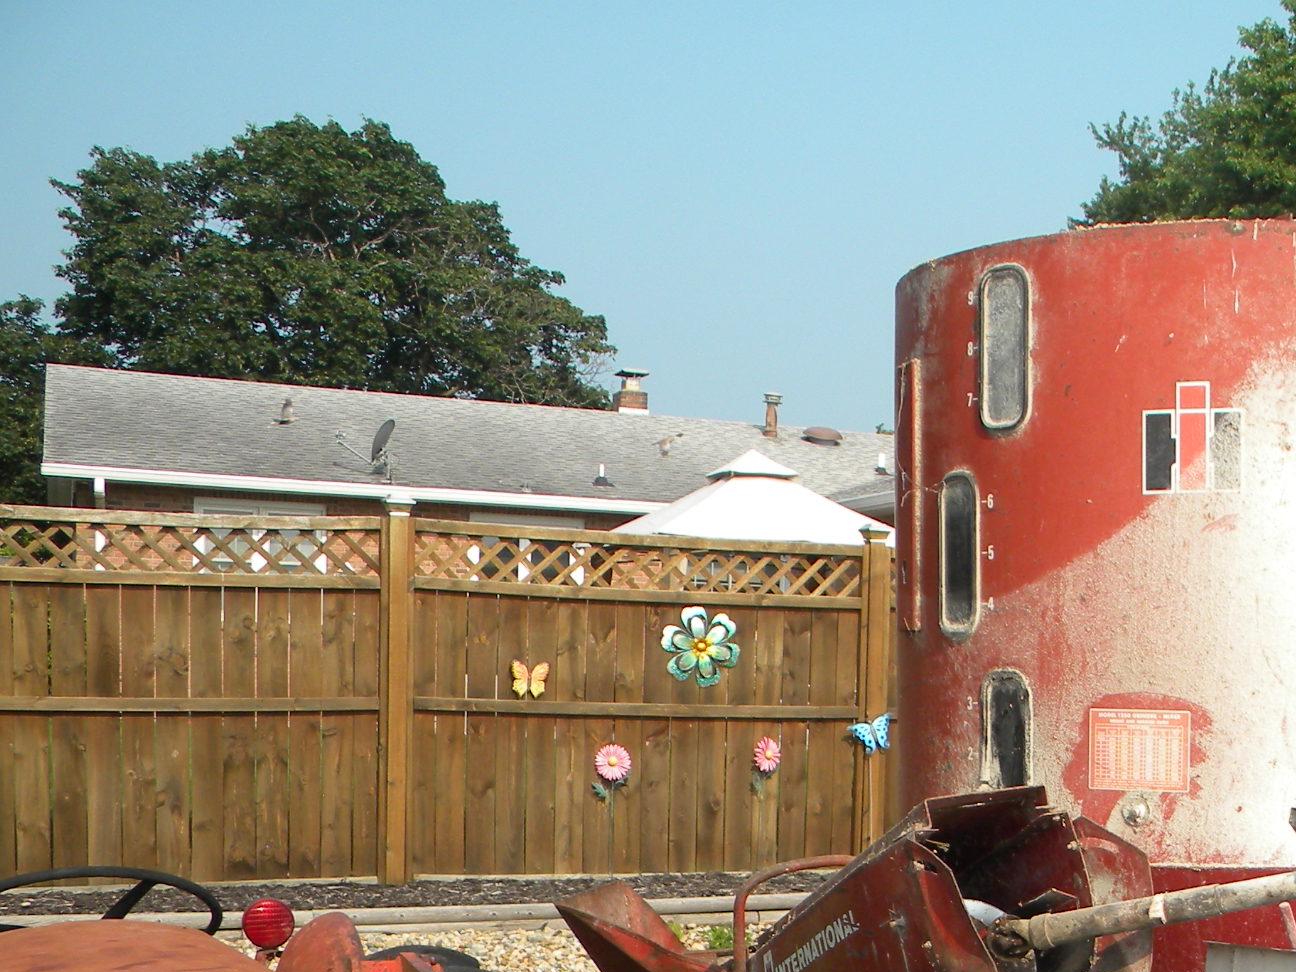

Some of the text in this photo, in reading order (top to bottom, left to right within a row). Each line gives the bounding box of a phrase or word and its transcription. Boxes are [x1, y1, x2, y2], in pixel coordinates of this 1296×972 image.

[967, 291, 974, 306] 9
[967, 341, 974, 356] 8
[966, 392, 974, 407] 7
[987, 493, 994, 509] 6
[987, 544, 995, 560] 5
[987, 597, 995, 611] 4
[966, 696, 973, 711] 3
